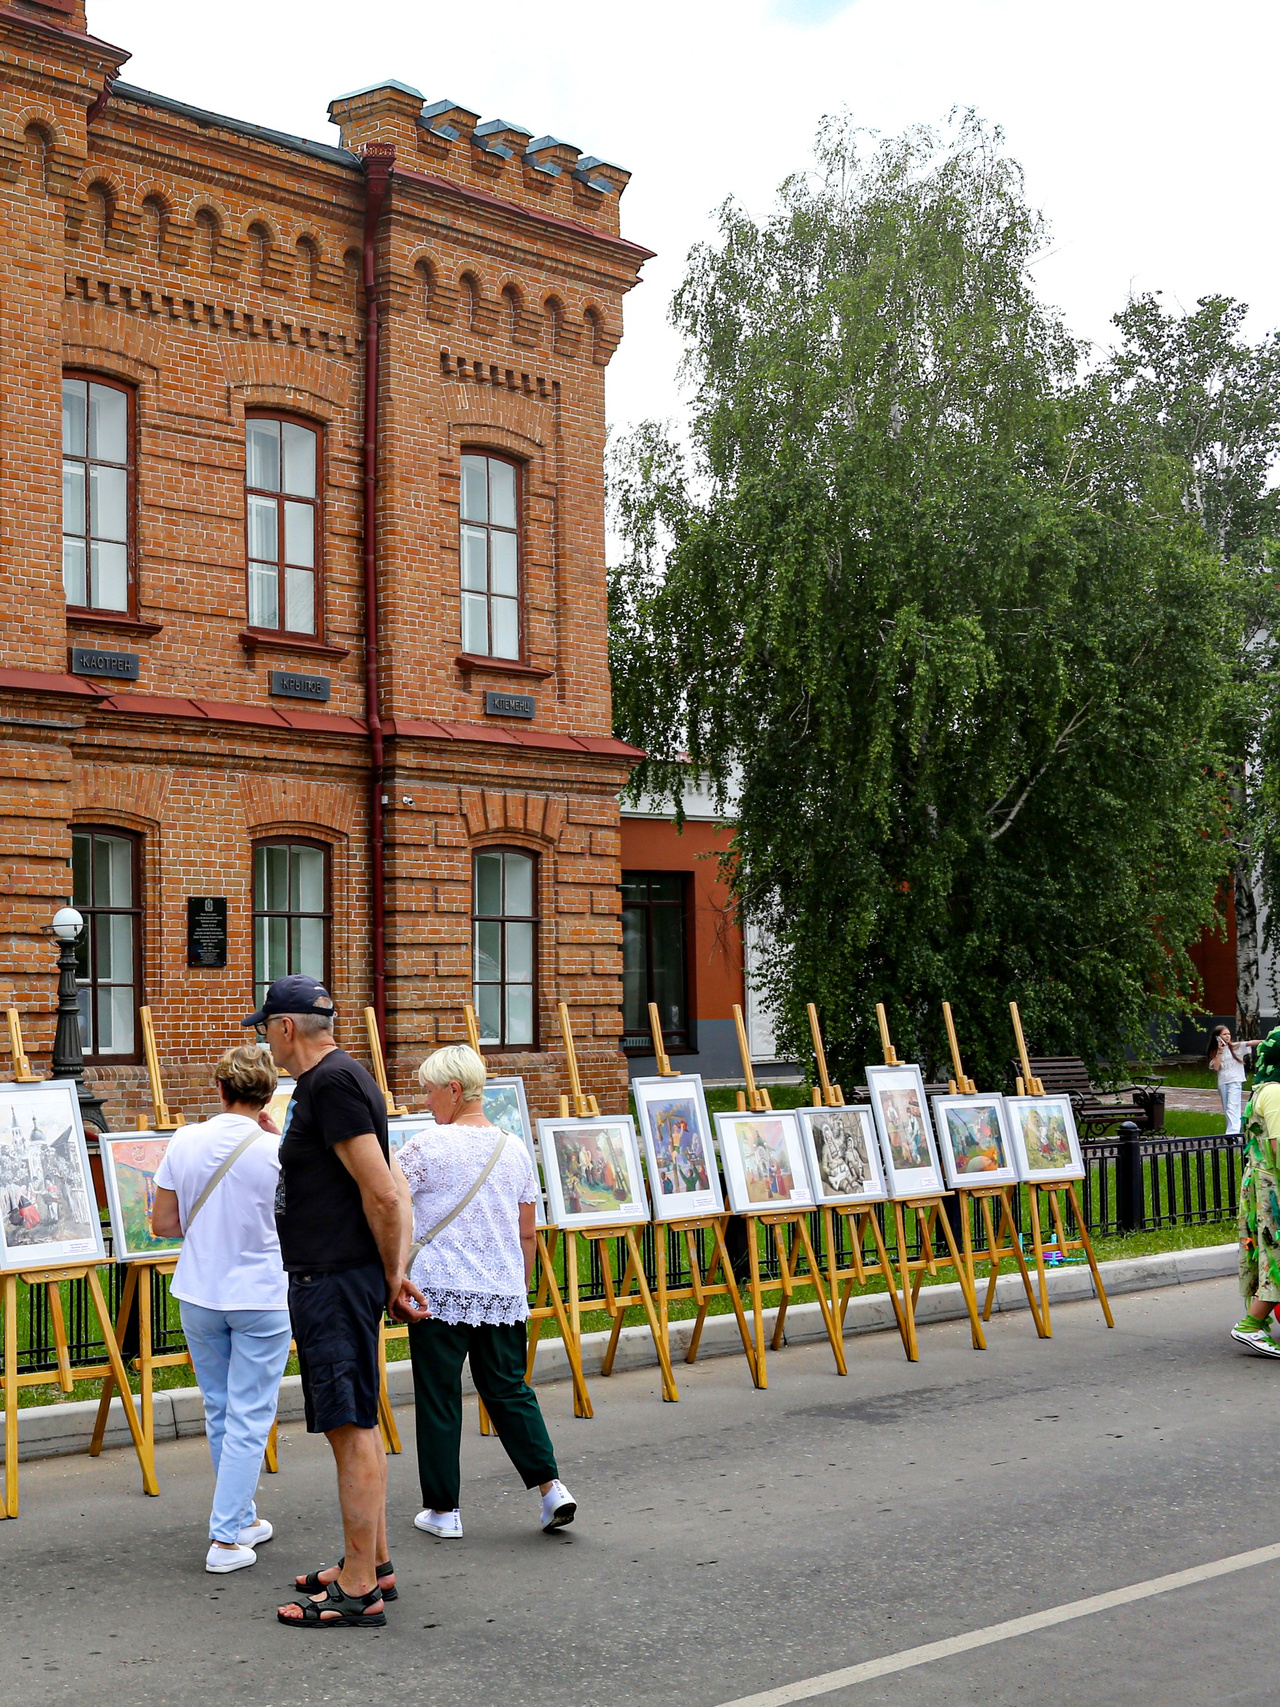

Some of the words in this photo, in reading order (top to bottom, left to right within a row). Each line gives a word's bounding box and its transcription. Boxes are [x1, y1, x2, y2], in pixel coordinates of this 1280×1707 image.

[83, 655, 131, 671] КАСТРЕН
[283, 678, 322, 693] КРЫЛОВ
[494, 698, 530, 712] КЛЕМЕНЦ
